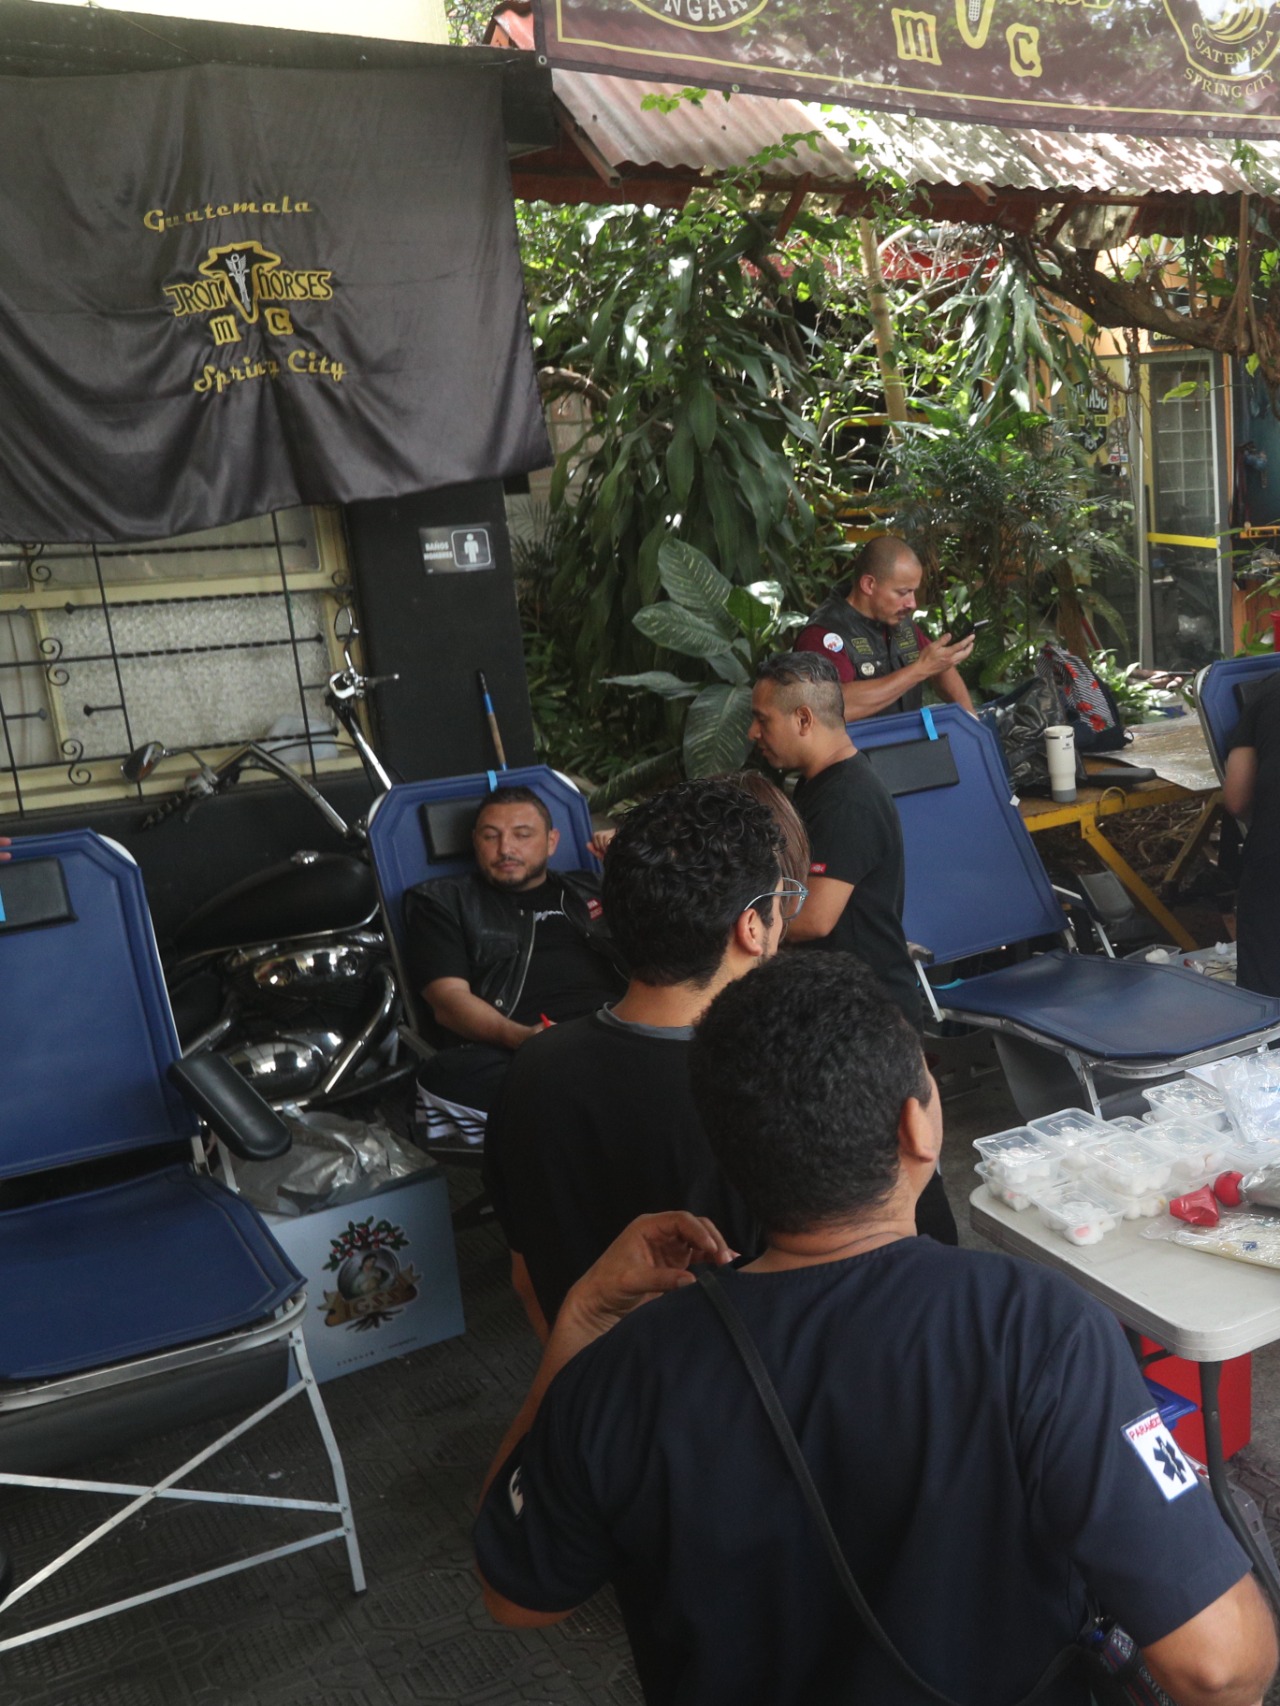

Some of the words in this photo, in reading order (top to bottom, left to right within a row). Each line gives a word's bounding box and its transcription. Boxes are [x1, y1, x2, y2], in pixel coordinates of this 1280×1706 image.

[1192, 23, 1274, 65] GUATEMALA
[1184, 67, 1242, 98] SPRING
[1245, 70, 1275, 96] CITY
[144, 196, 313, 232] Guatemala
[194, 357, 279, 393] Spring
[288, 349, 347, 381] City
[344, 1289, 399, 1319] IGSS
